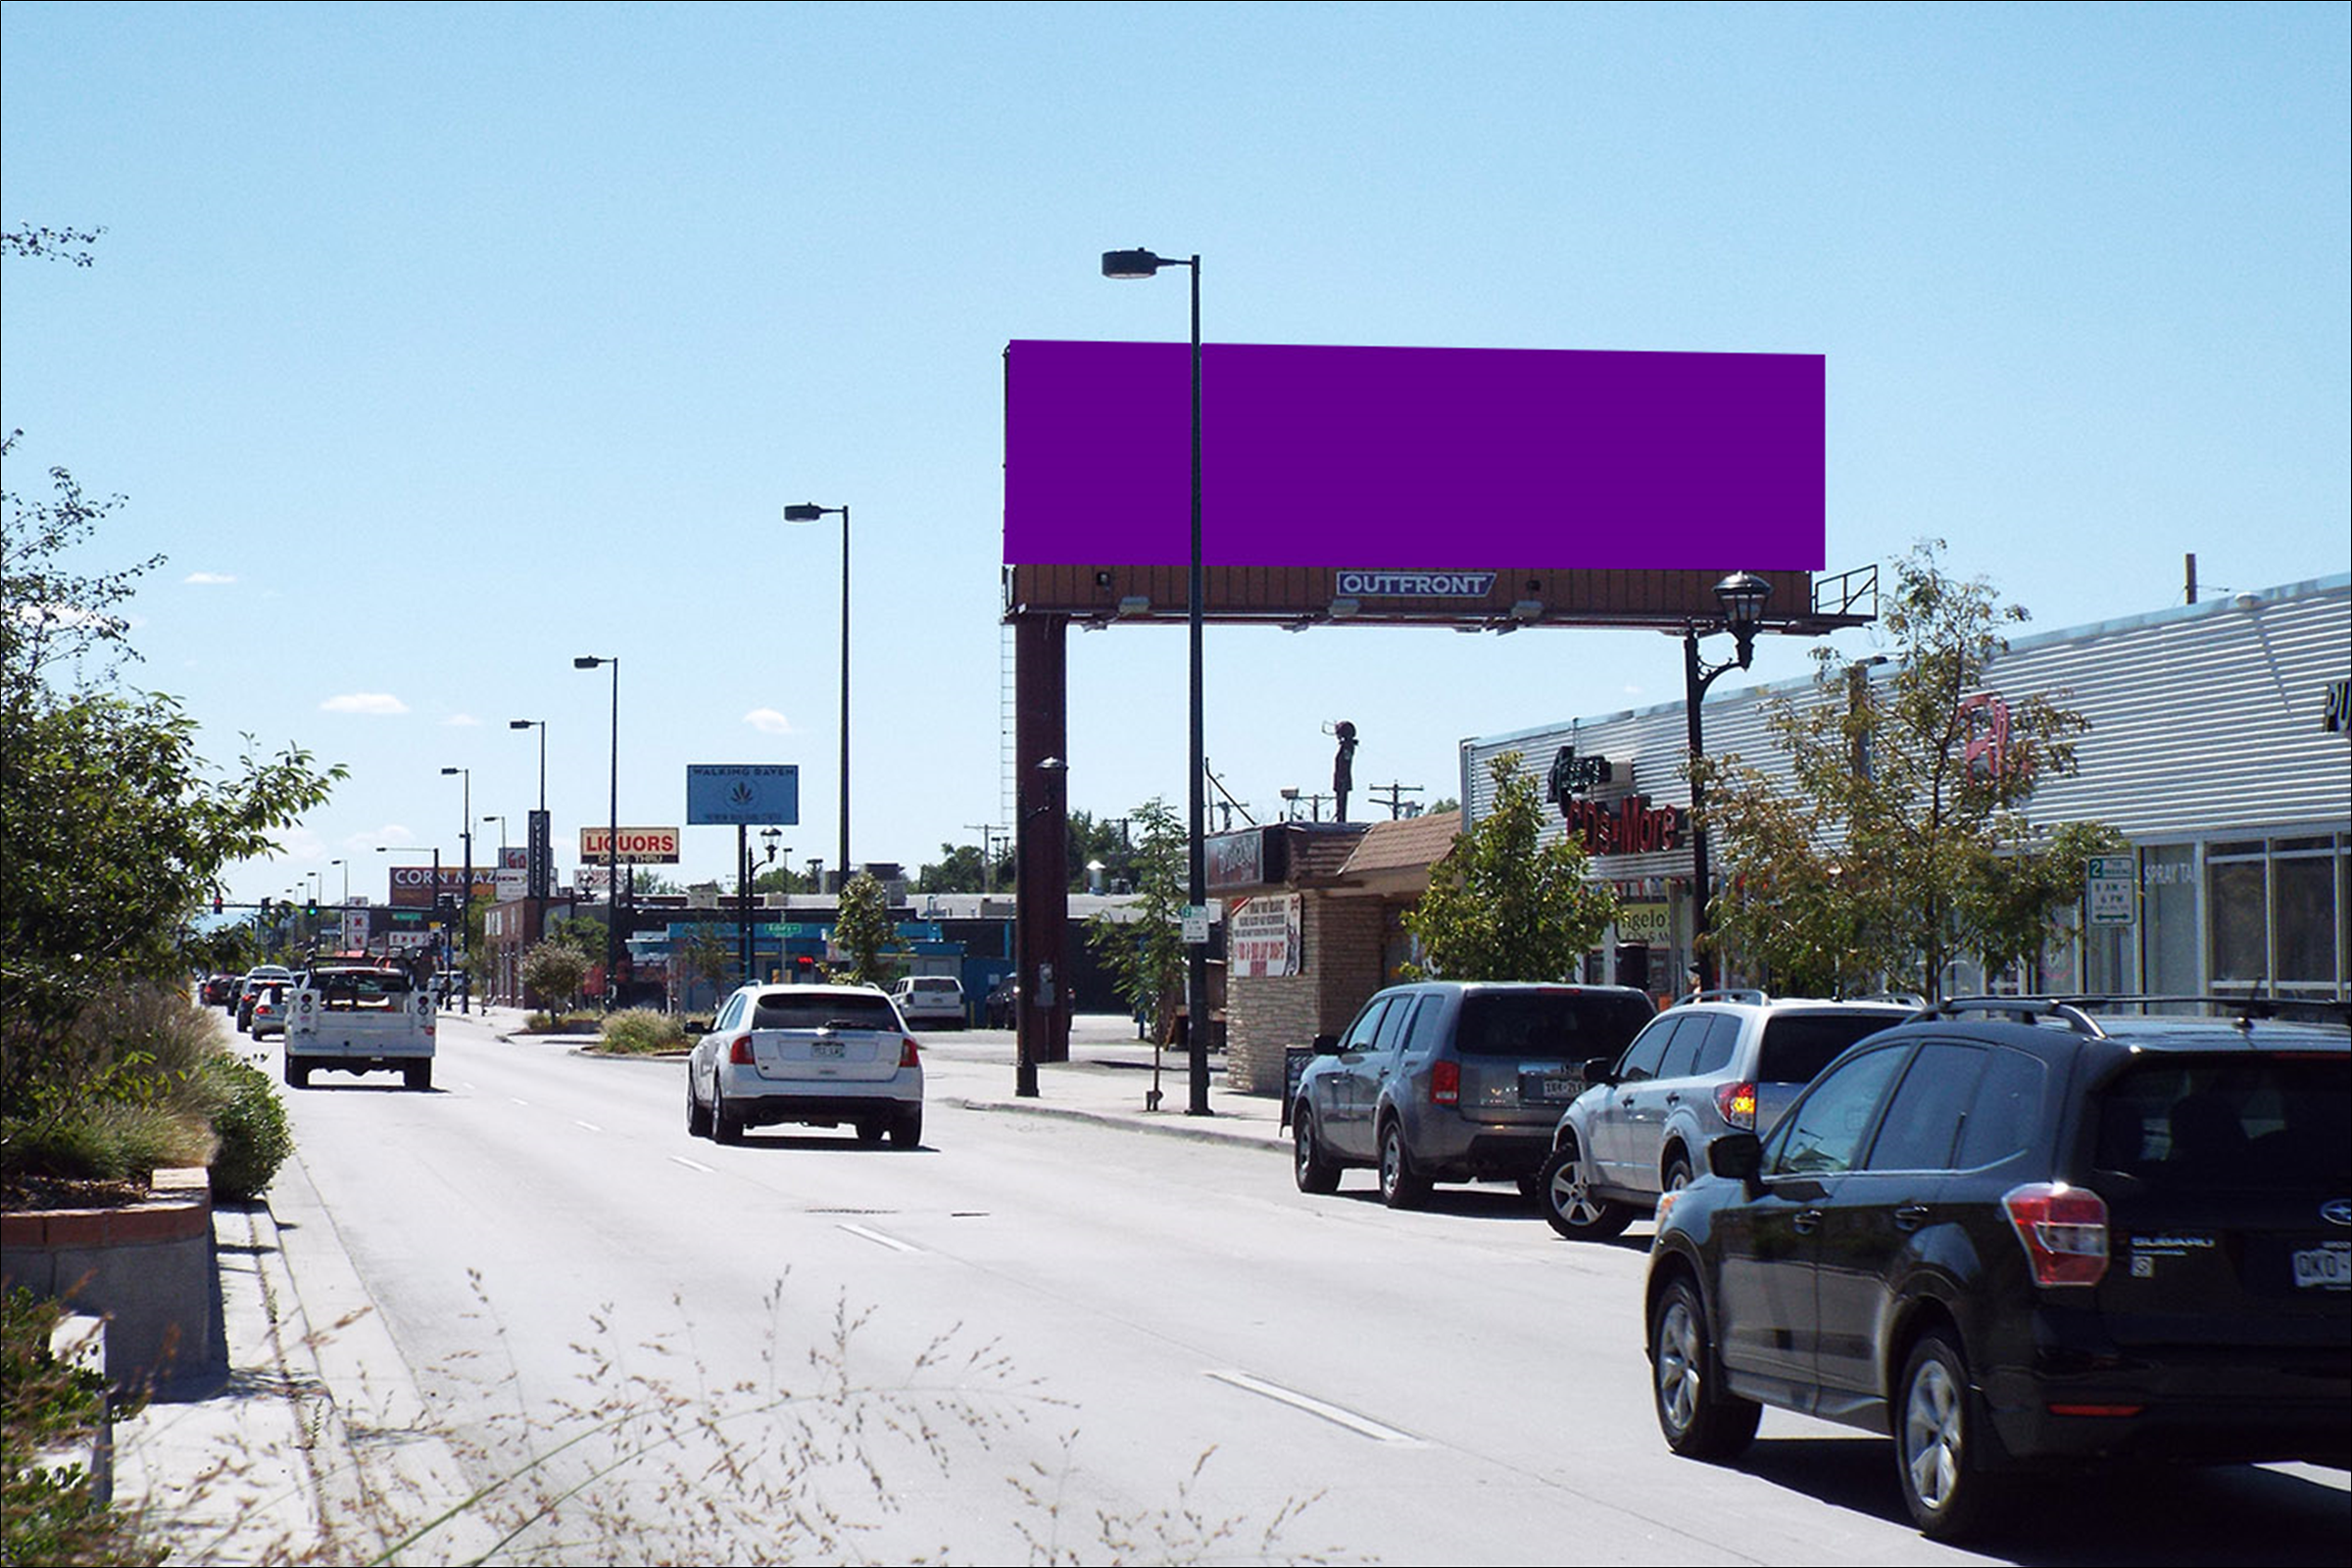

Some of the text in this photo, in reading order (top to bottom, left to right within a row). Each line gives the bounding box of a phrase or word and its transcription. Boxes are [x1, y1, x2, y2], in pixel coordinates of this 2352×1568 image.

[1343, 574, 1487, 594] OUTFRONT
[691, 767, 750, 776] WALKING
[454, 868, 496, 885] MAZ
[2089, 859, 2101, 877] 2
